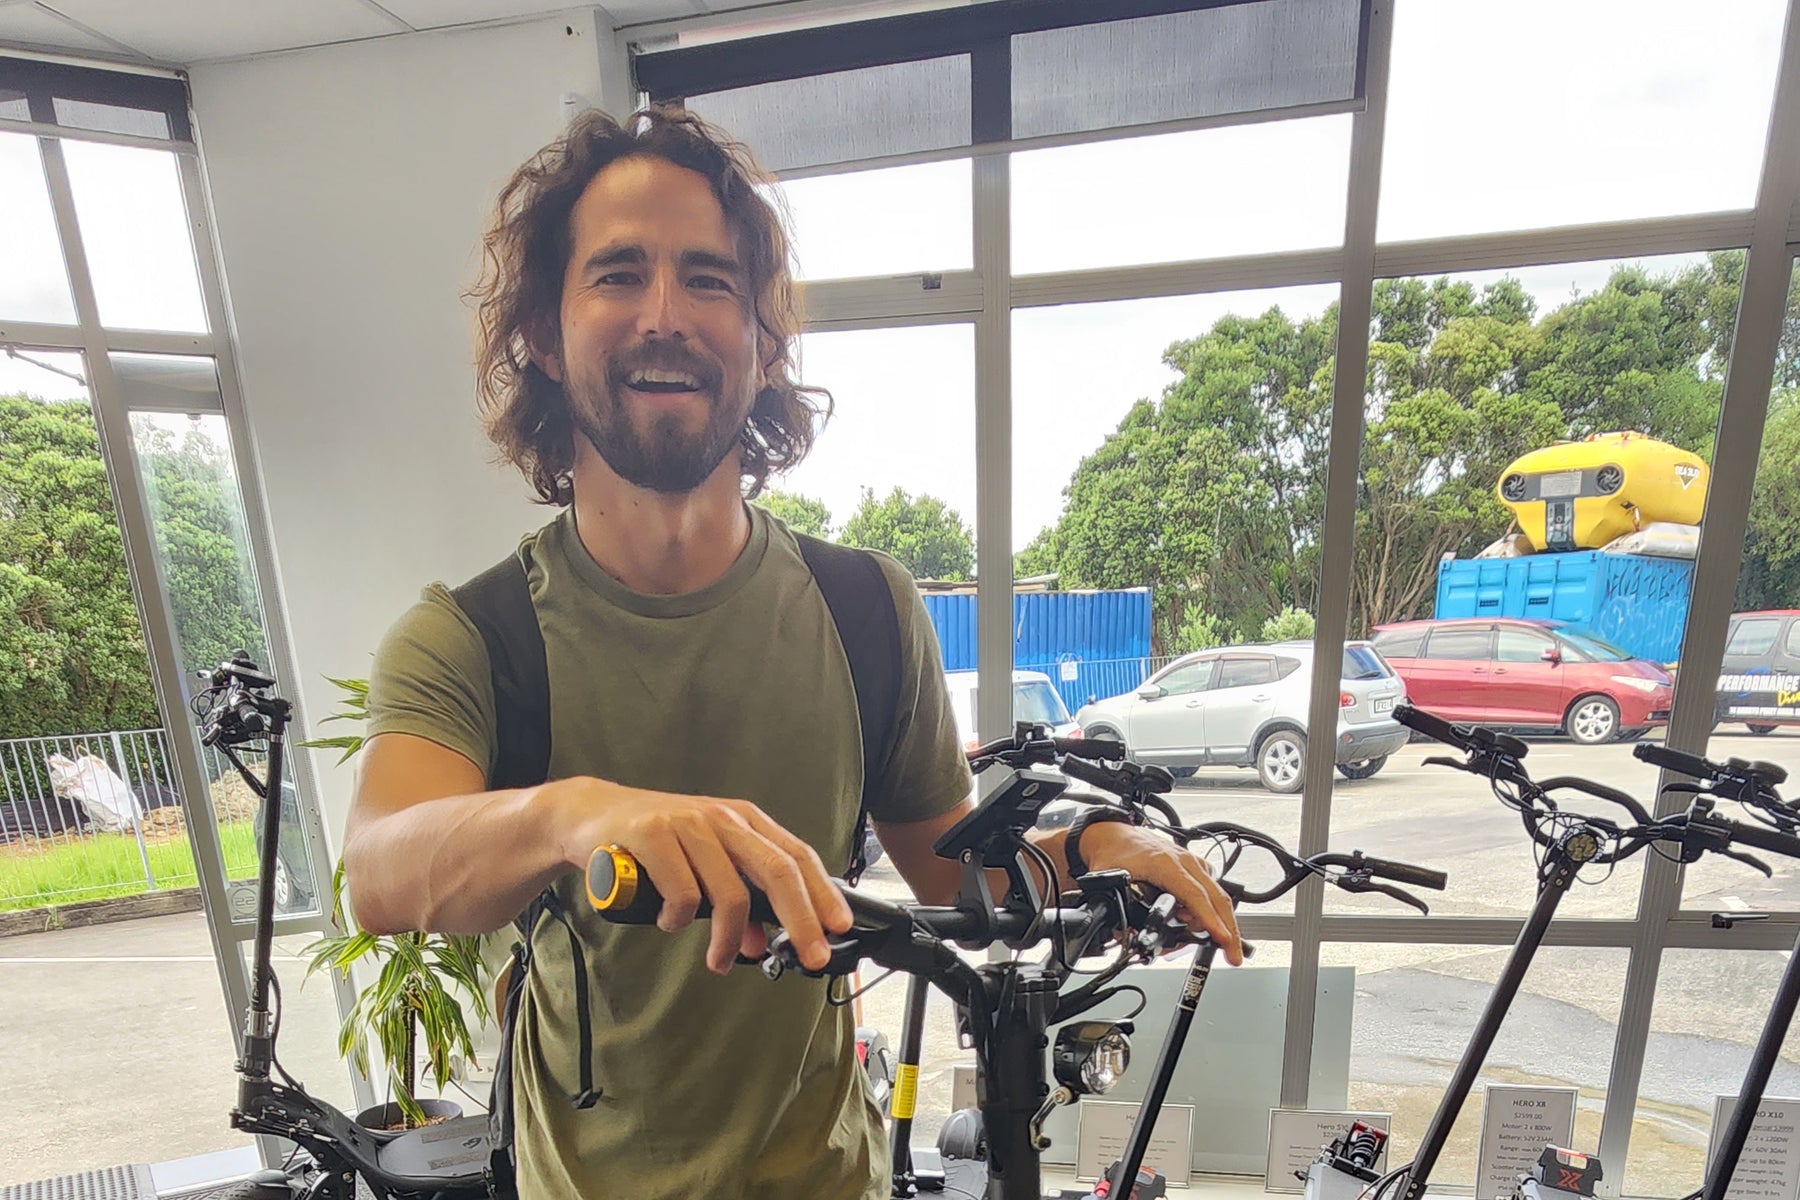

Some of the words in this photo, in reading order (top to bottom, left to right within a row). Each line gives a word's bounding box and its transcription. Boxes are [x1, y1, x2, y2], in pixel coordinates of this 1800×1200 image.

[1716, 674, 1800, 692] PERFORMANCE
[1512, 1100, 1535, 1108] HERO
[1767, 1111, 1784, 1119] X10
